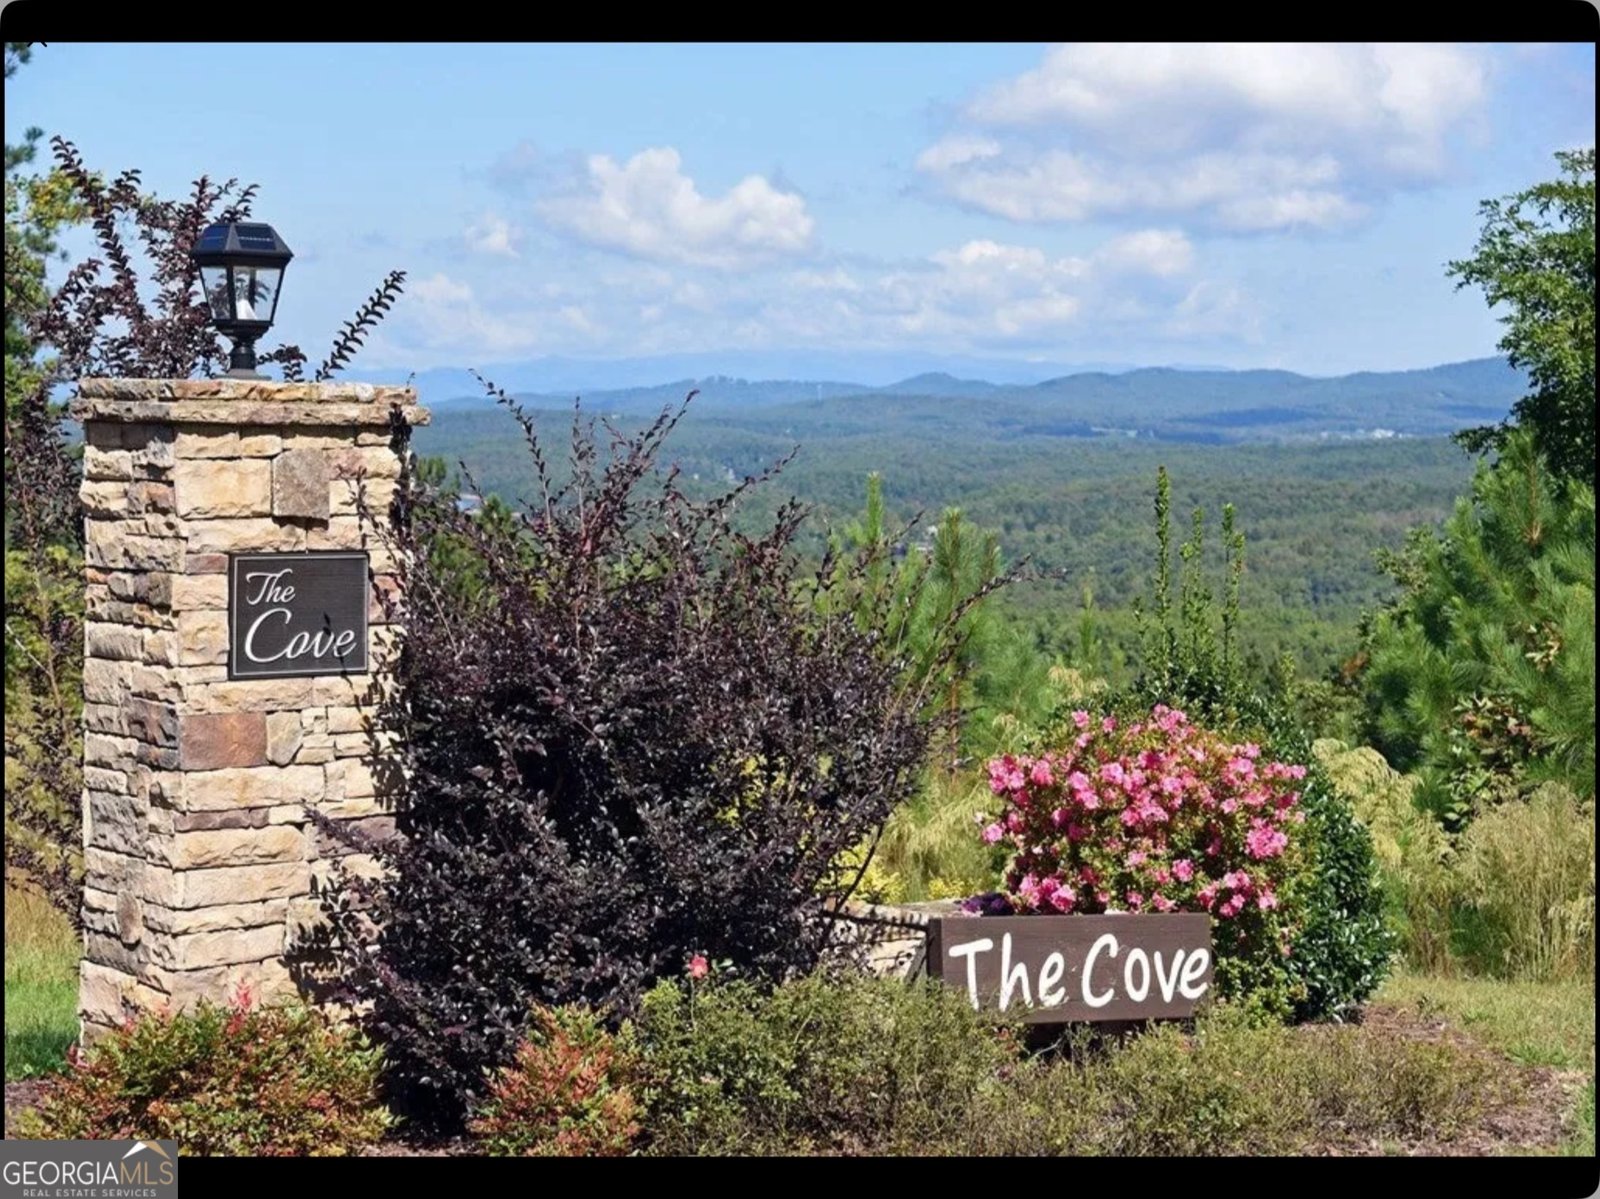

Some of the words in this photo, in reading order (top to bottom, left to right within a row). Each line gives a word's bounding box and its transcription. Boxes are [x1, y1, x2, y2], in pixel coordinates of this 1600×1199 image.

[245, 568, 296, 605] The
[244, 607, 357, 663] Cove
[948, 932, 1067, 1013] The
[1081, 933, 1210, 1008] Cove
